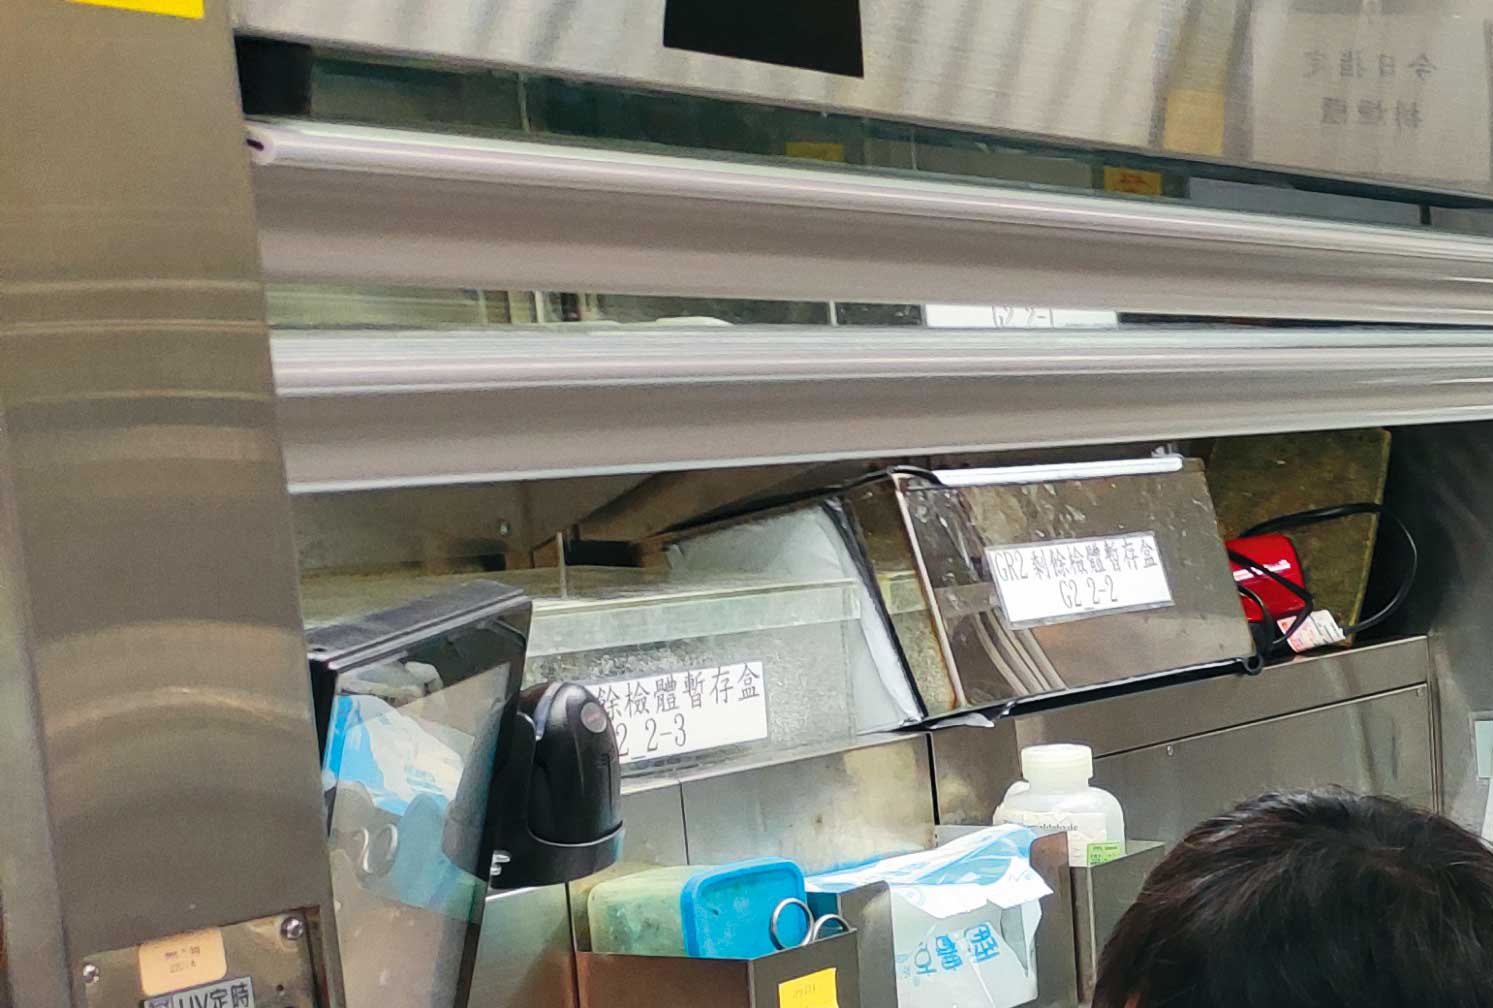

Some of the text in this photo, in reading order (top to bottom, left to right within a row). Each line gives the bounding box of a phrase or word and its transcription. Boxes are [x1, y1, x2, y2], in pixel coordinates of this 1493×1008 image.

[994, 551, 1029, 582] GR2
[1059, 574, 1118, 609] G2 2-2
[645, 713, 687, 752] 2-3
